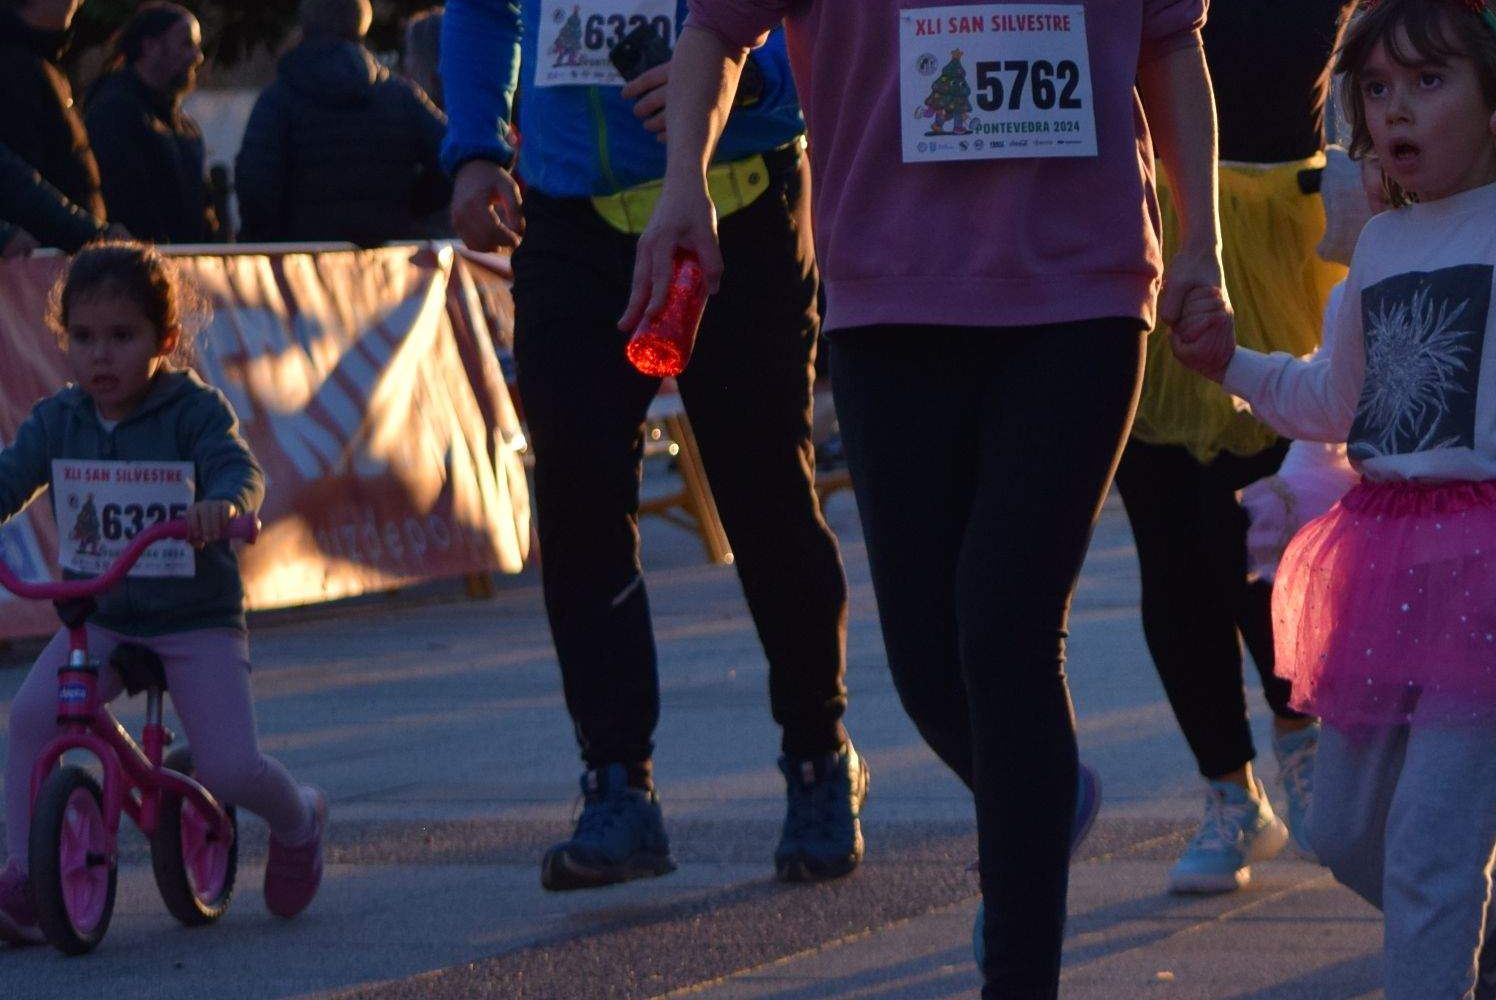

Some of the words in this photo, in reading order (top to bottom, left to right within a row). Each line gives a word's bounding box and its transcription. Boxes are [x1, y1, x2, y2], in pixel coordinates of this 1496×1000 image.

[915, 18, 941, 36] XLI
[948, 16, 984, 33] SAN
[991, 14, 1071, 32] SILVESTRE
[976, 60, 1082, 111] 5762
[975, 121, 1050, 134] PONTEVEDRA
[1053, 120, 1080, 132] 2024
[86, 467, 111, 481] SAN
[116, 467, 182, 482] SILVESTRE
